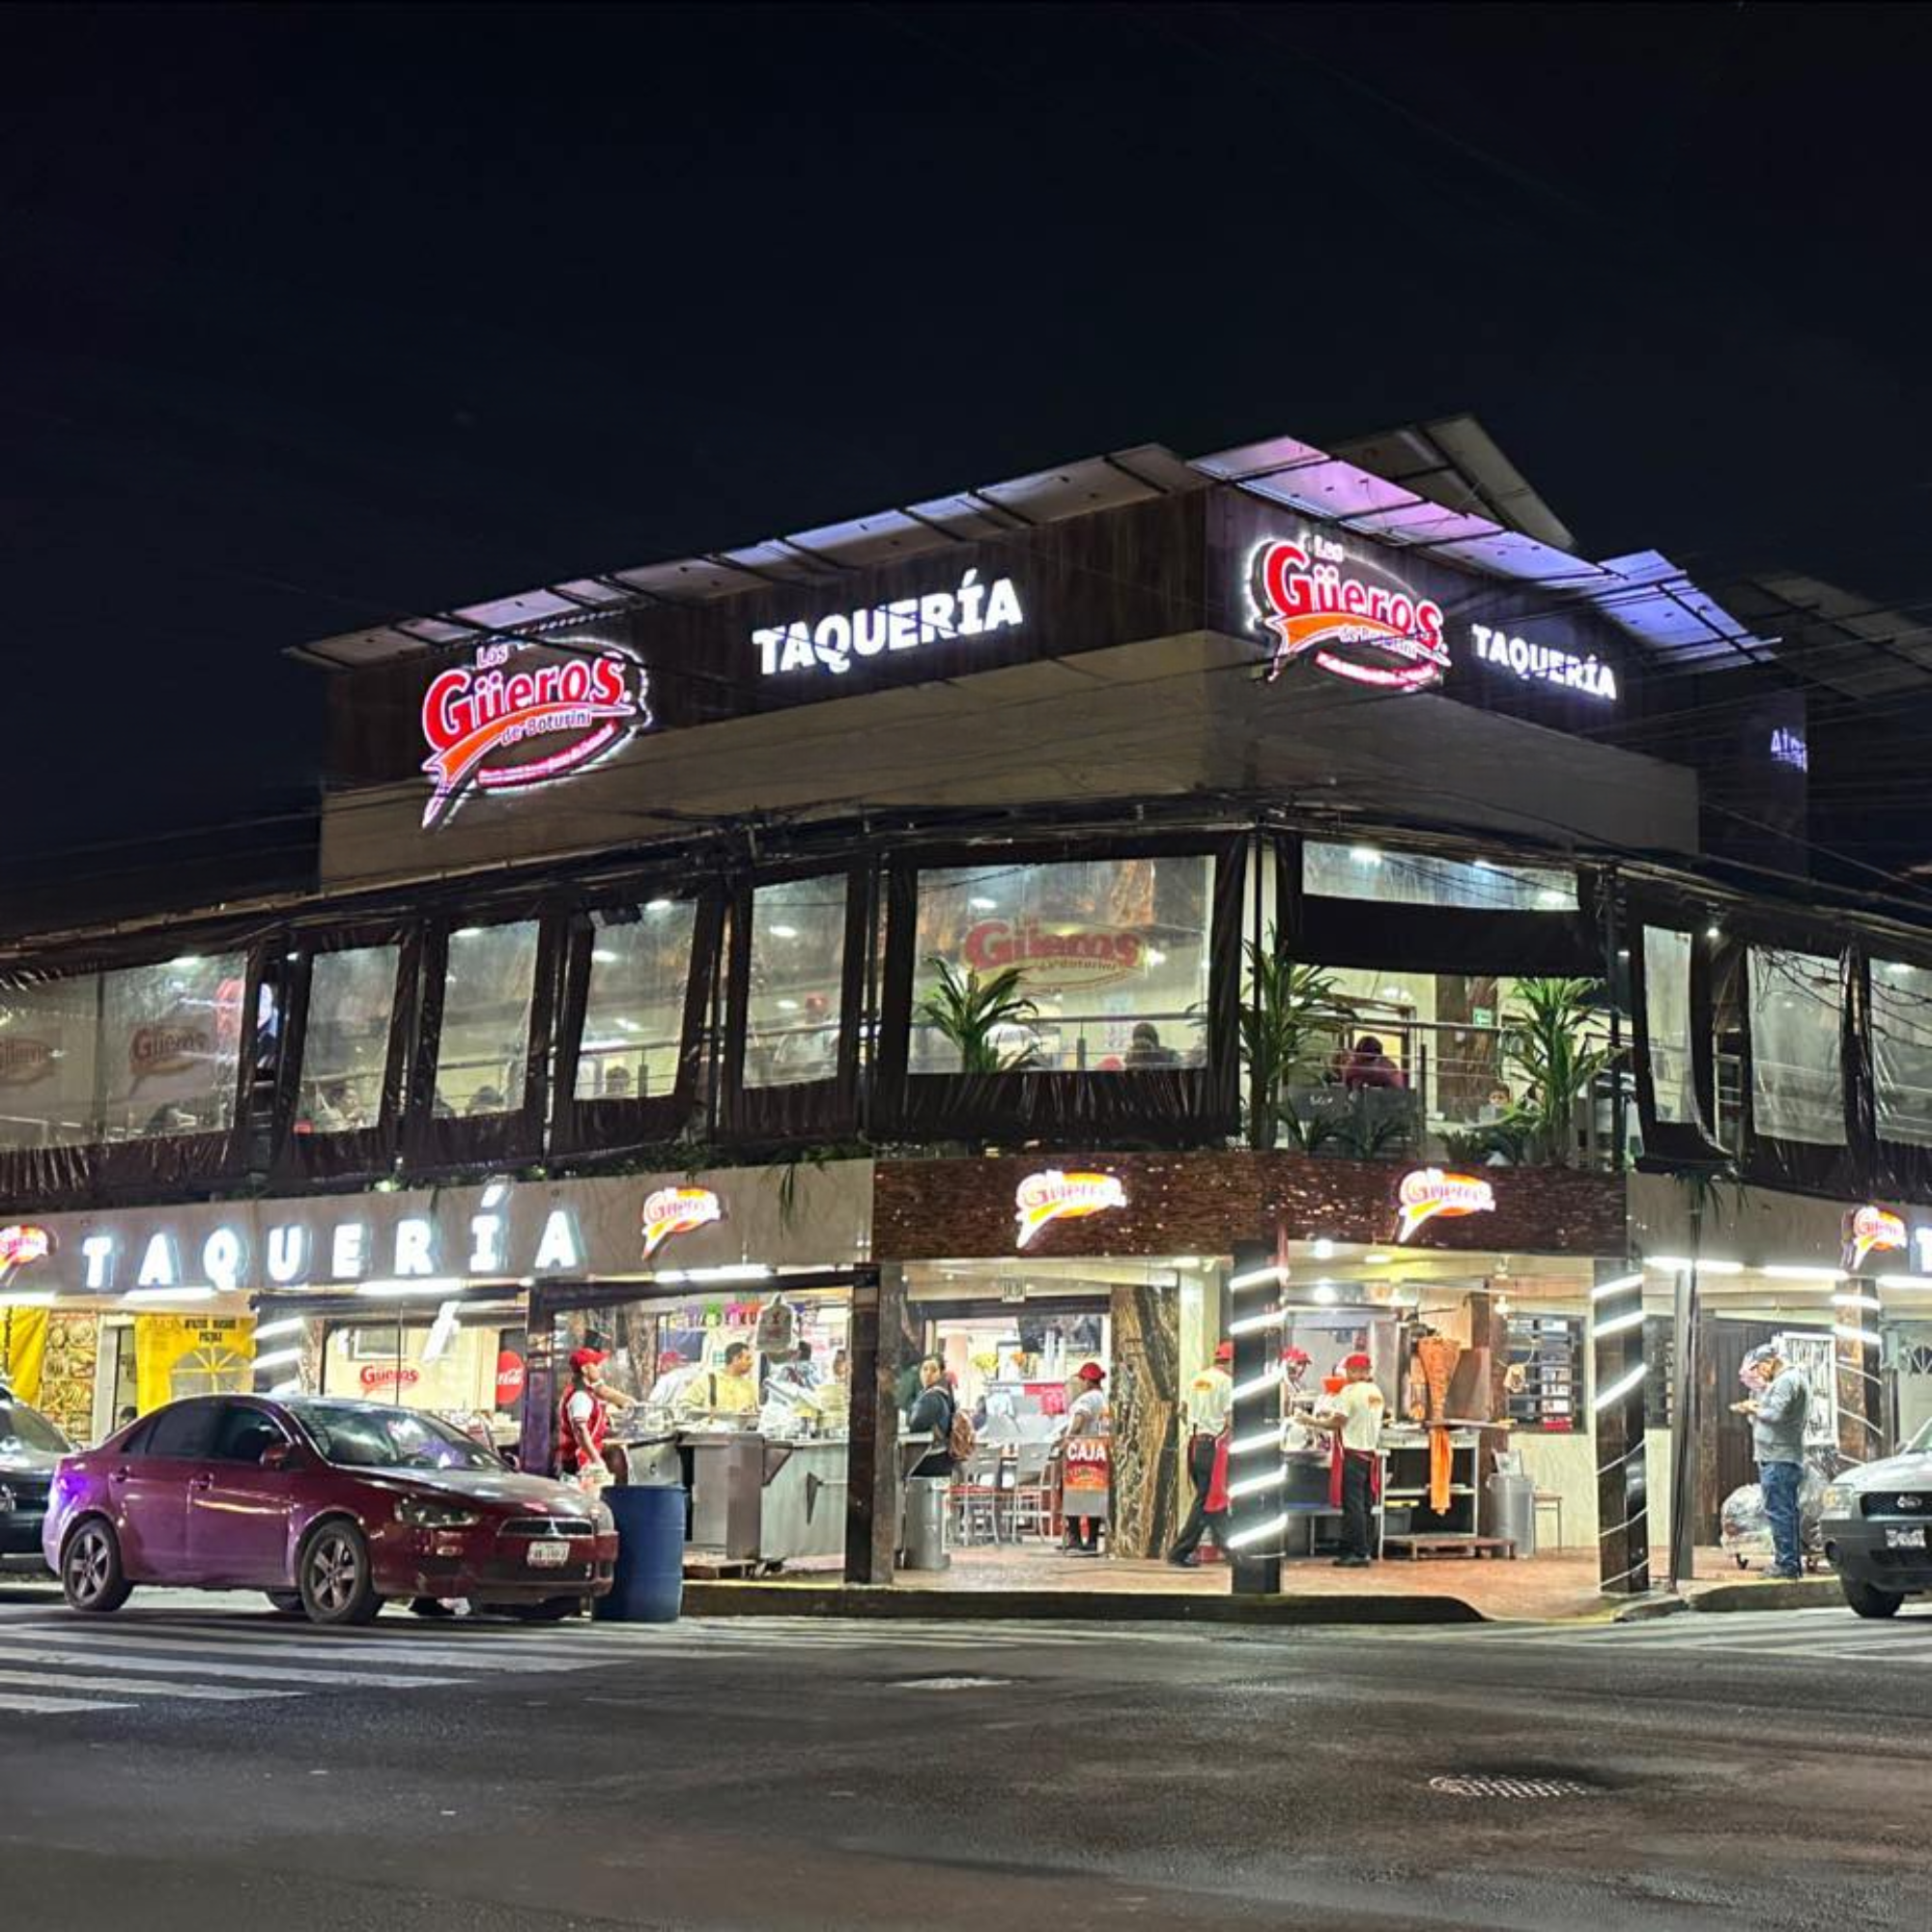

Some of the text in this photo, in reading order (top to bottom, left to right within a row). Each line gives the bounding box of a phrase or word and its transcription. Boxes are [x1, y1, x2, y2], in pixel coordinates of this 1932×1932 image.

[1314, 534, 1343, 562] Los
[752, 568, 1024, 675] TAQUERÍA
[1264, 541, 1443, 651] Güeros
[476, 643, 509, 668] Los
[1471, 623, 1617, 700] TAQUERÍA
[422, 653, 625, 751] Güeros
[82, 1179, 580, 1293] TAQUERÍA
[1067, 1441, 1106, 1462] CAJA
